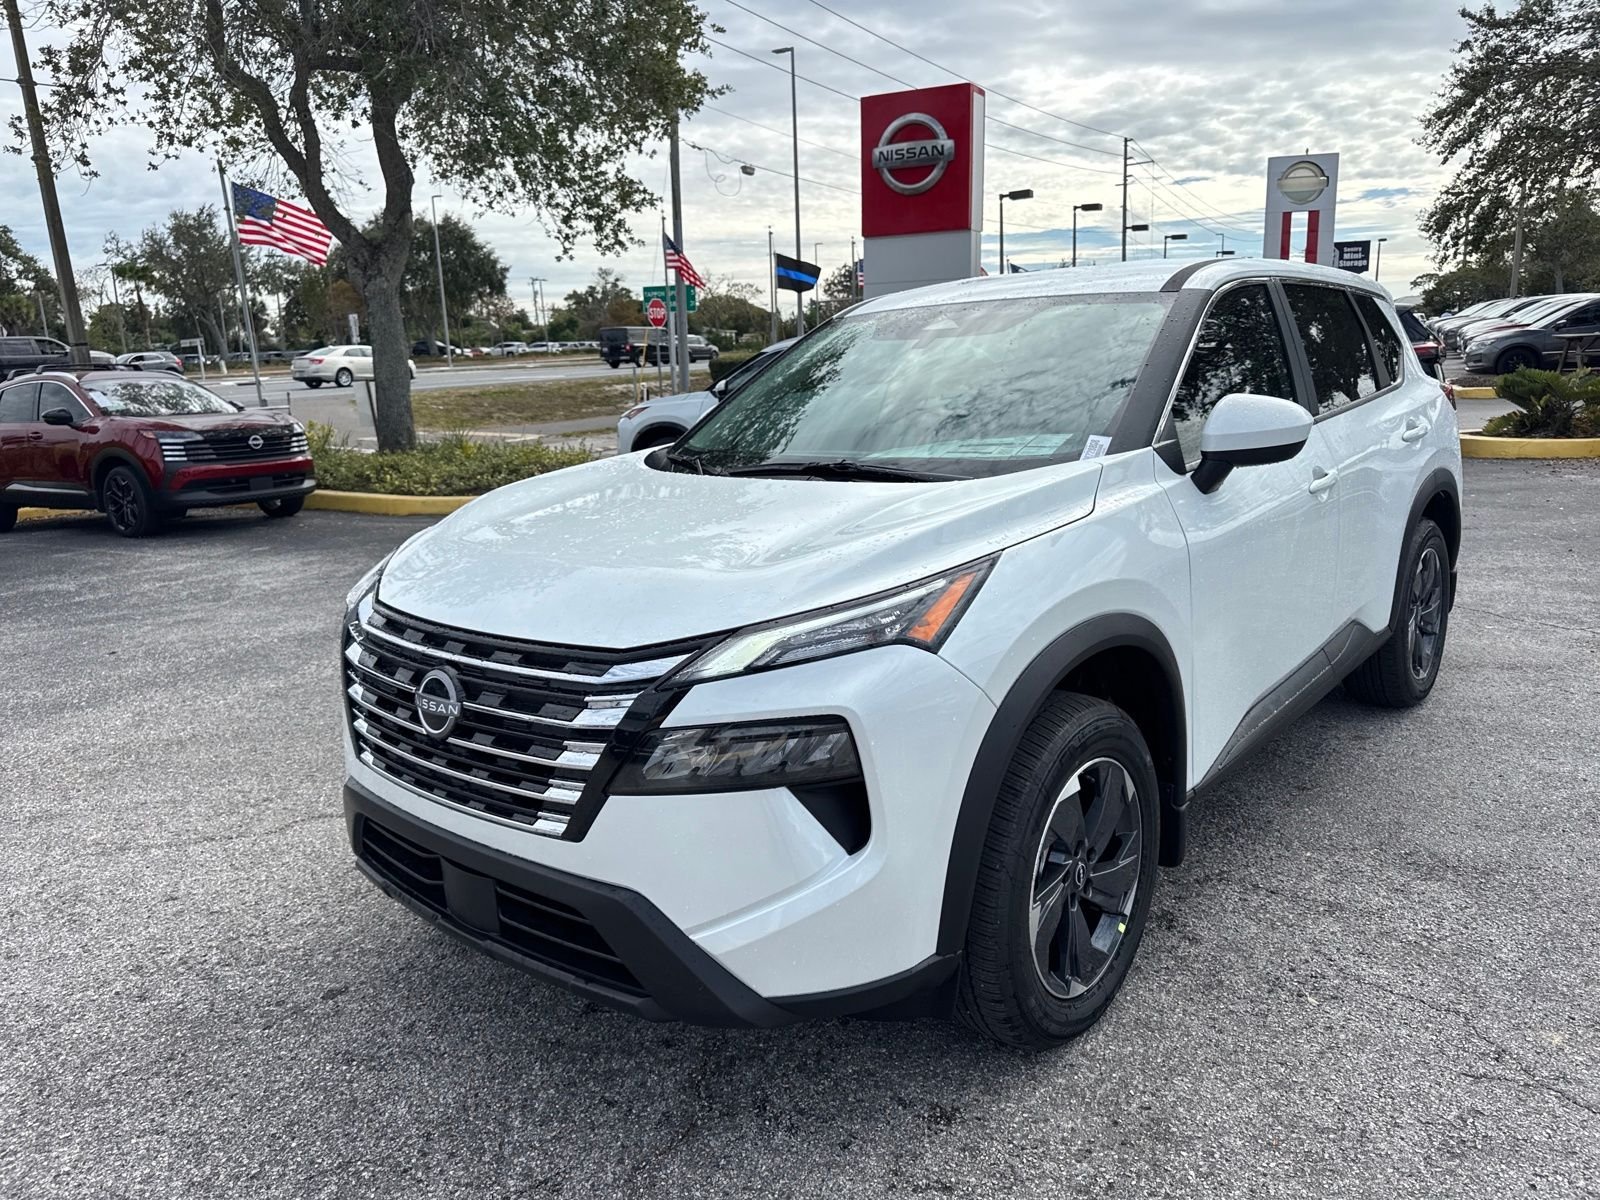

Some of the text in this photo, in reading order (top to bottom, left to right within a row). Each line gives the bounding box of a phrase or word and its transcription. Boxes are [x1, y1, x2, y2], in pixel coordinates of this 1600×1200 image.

[878, 144, 945, 163] NISSAN
[1343, 252, 1365, 260] Mini-
[1339, 259, 1368, 267] Storage
[649, 307, 665, 319] STOP
